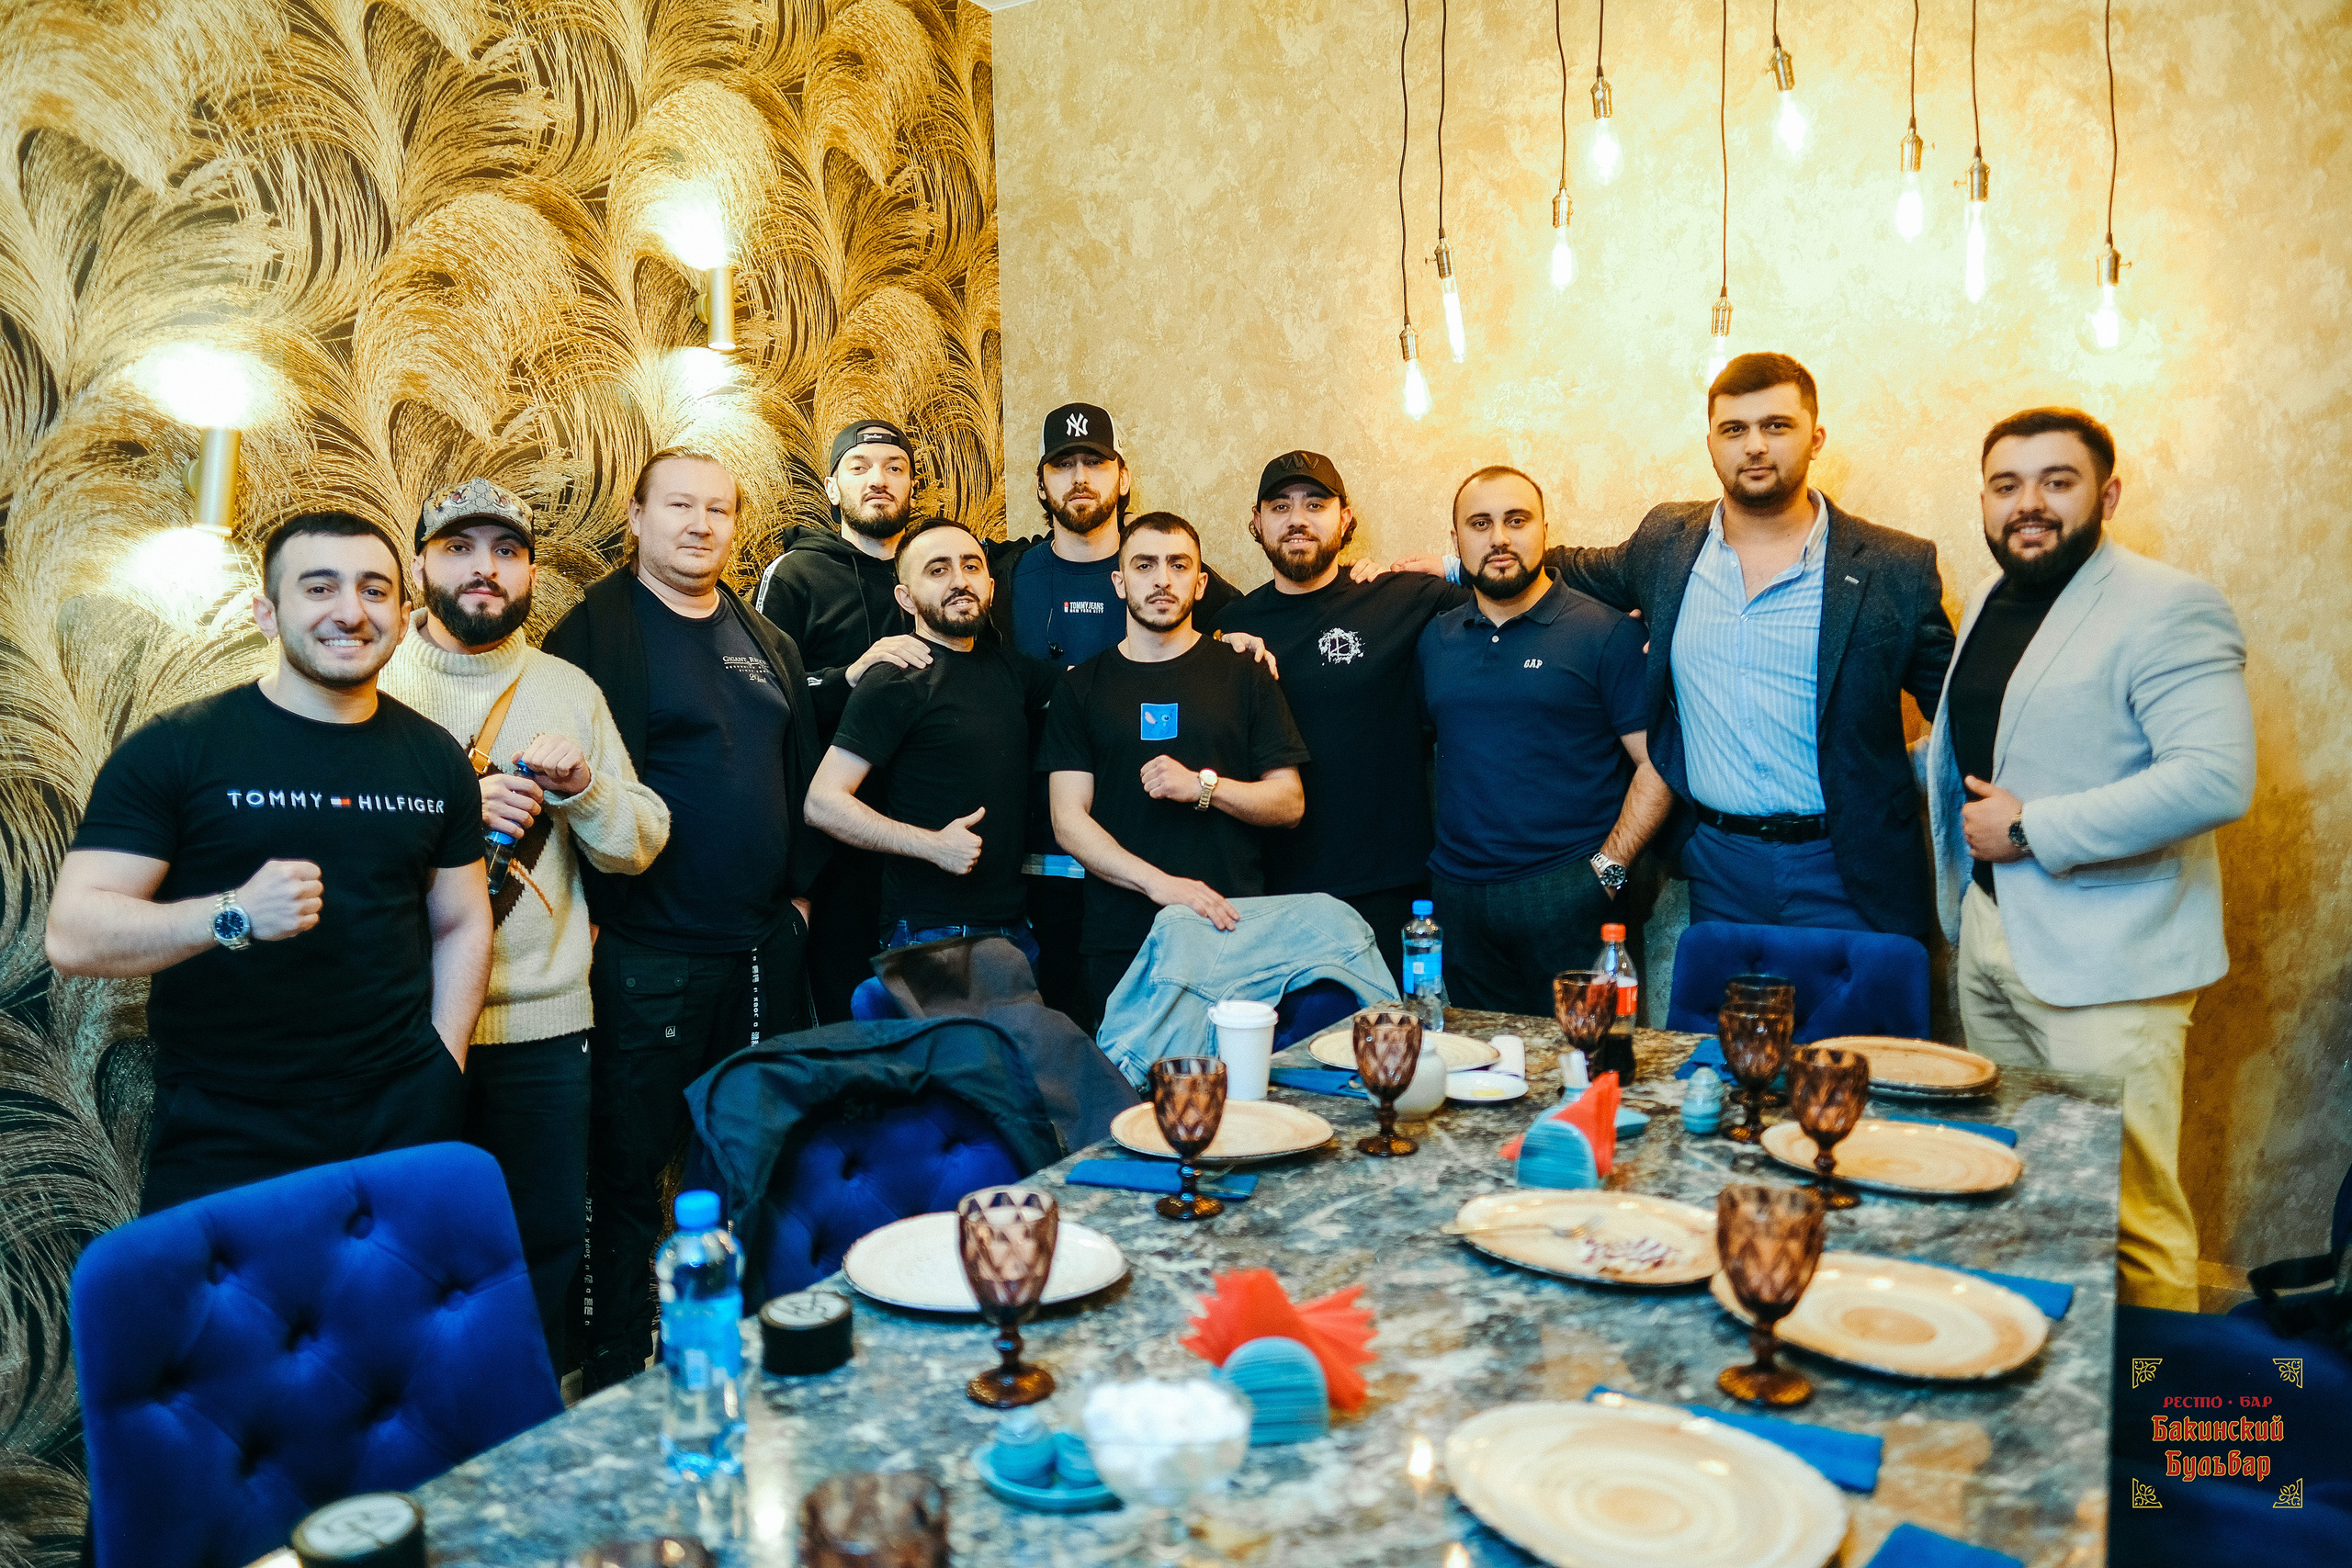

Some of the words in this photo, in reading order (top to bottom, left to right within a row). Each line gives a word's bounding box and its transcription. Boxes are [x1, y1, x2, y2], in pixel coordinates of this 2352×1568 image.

[1066, 412, 1089, 437] NY
[1523, 658, 1544, 669] GAP
[227, 789, 322, 809] TOMMY
[358, 793, 445, 814] HILFIGER
